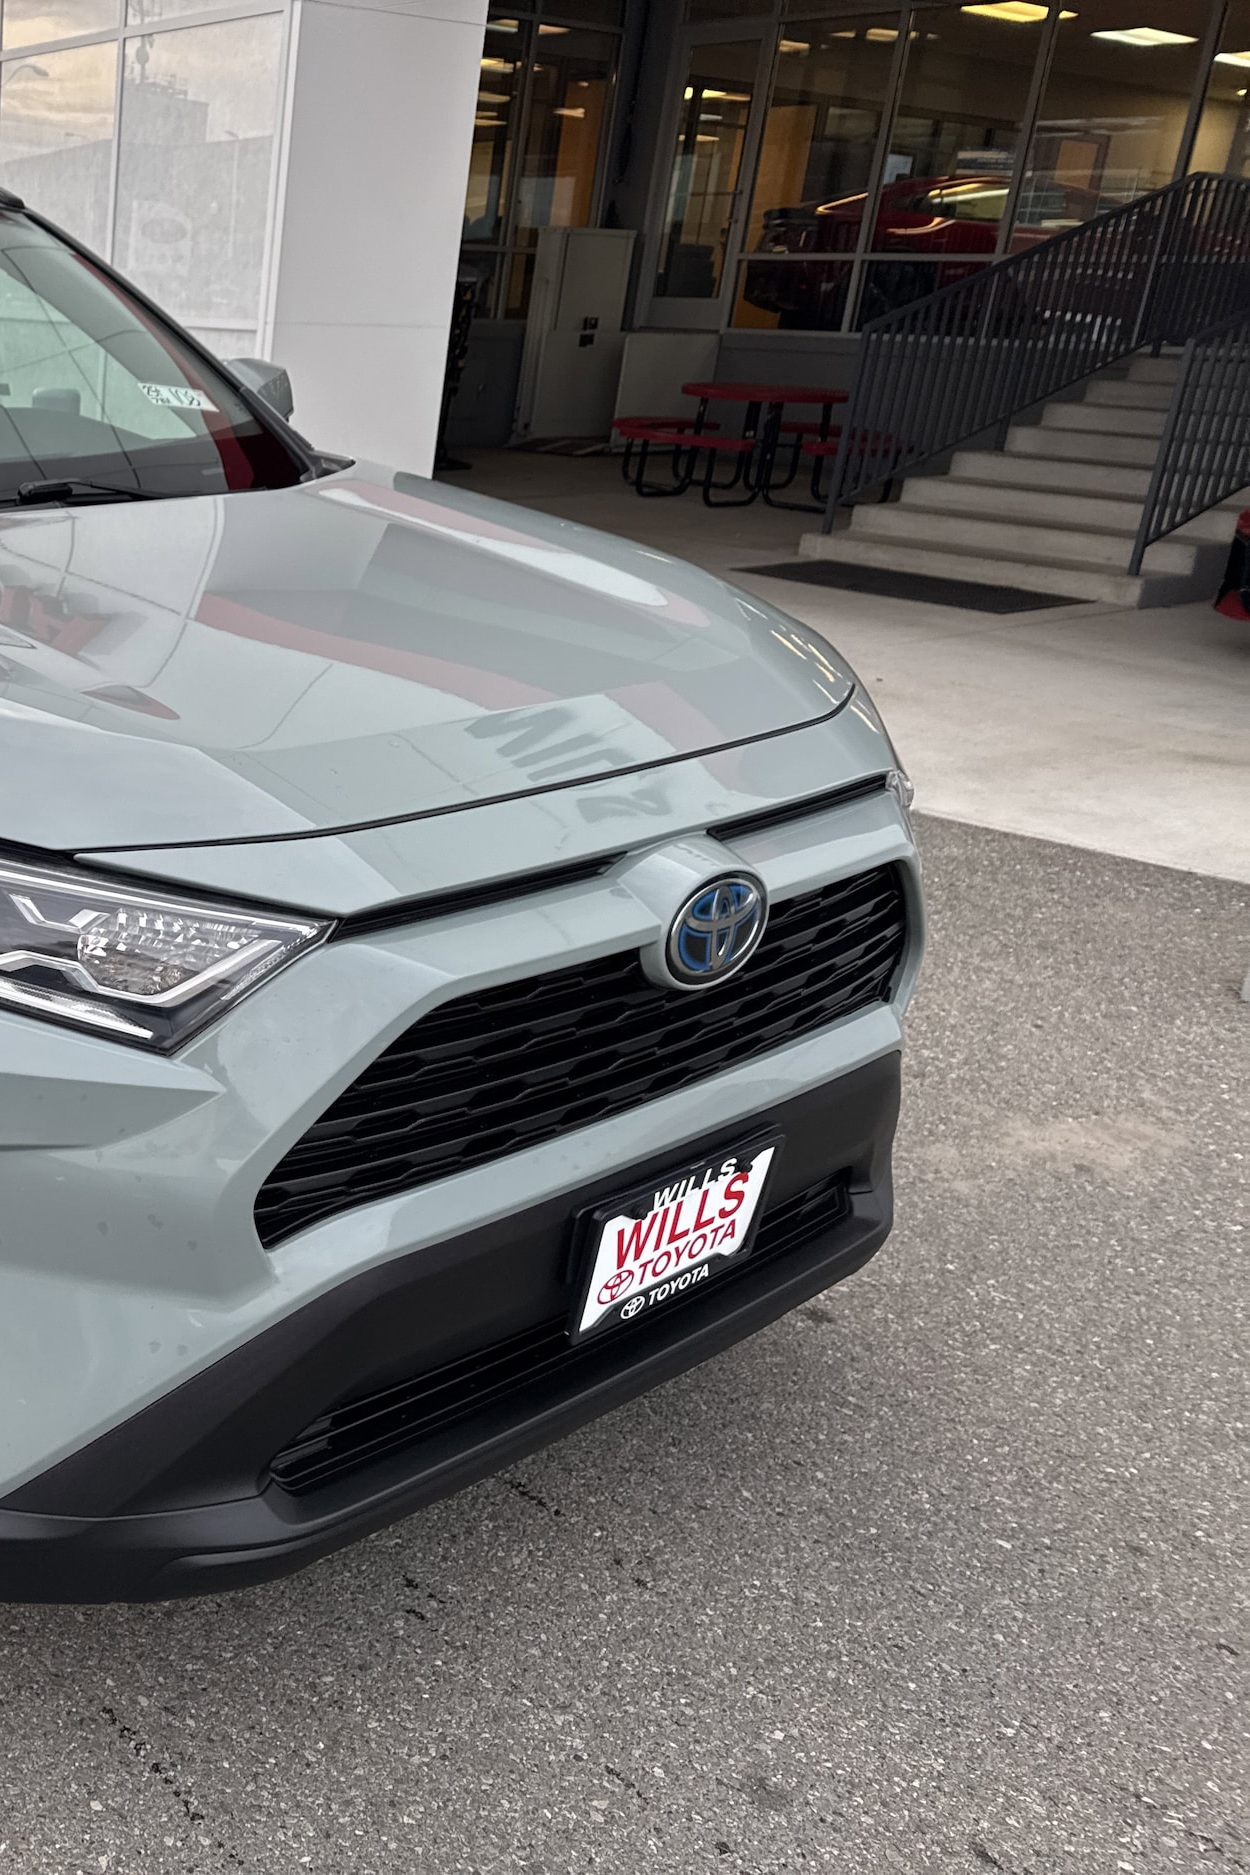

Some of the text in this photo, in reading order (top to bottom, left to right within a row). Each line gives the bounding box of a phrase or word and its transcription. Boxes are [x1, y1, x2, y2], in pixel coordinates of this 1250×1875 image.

[653, 1157, 738, 1211] WILLS
[616, 1171, 749, 1270] WILLS
[638, 1218, 736, 1285] TOYOTA
[648, 1263, 709, 1306] TOYOTA
